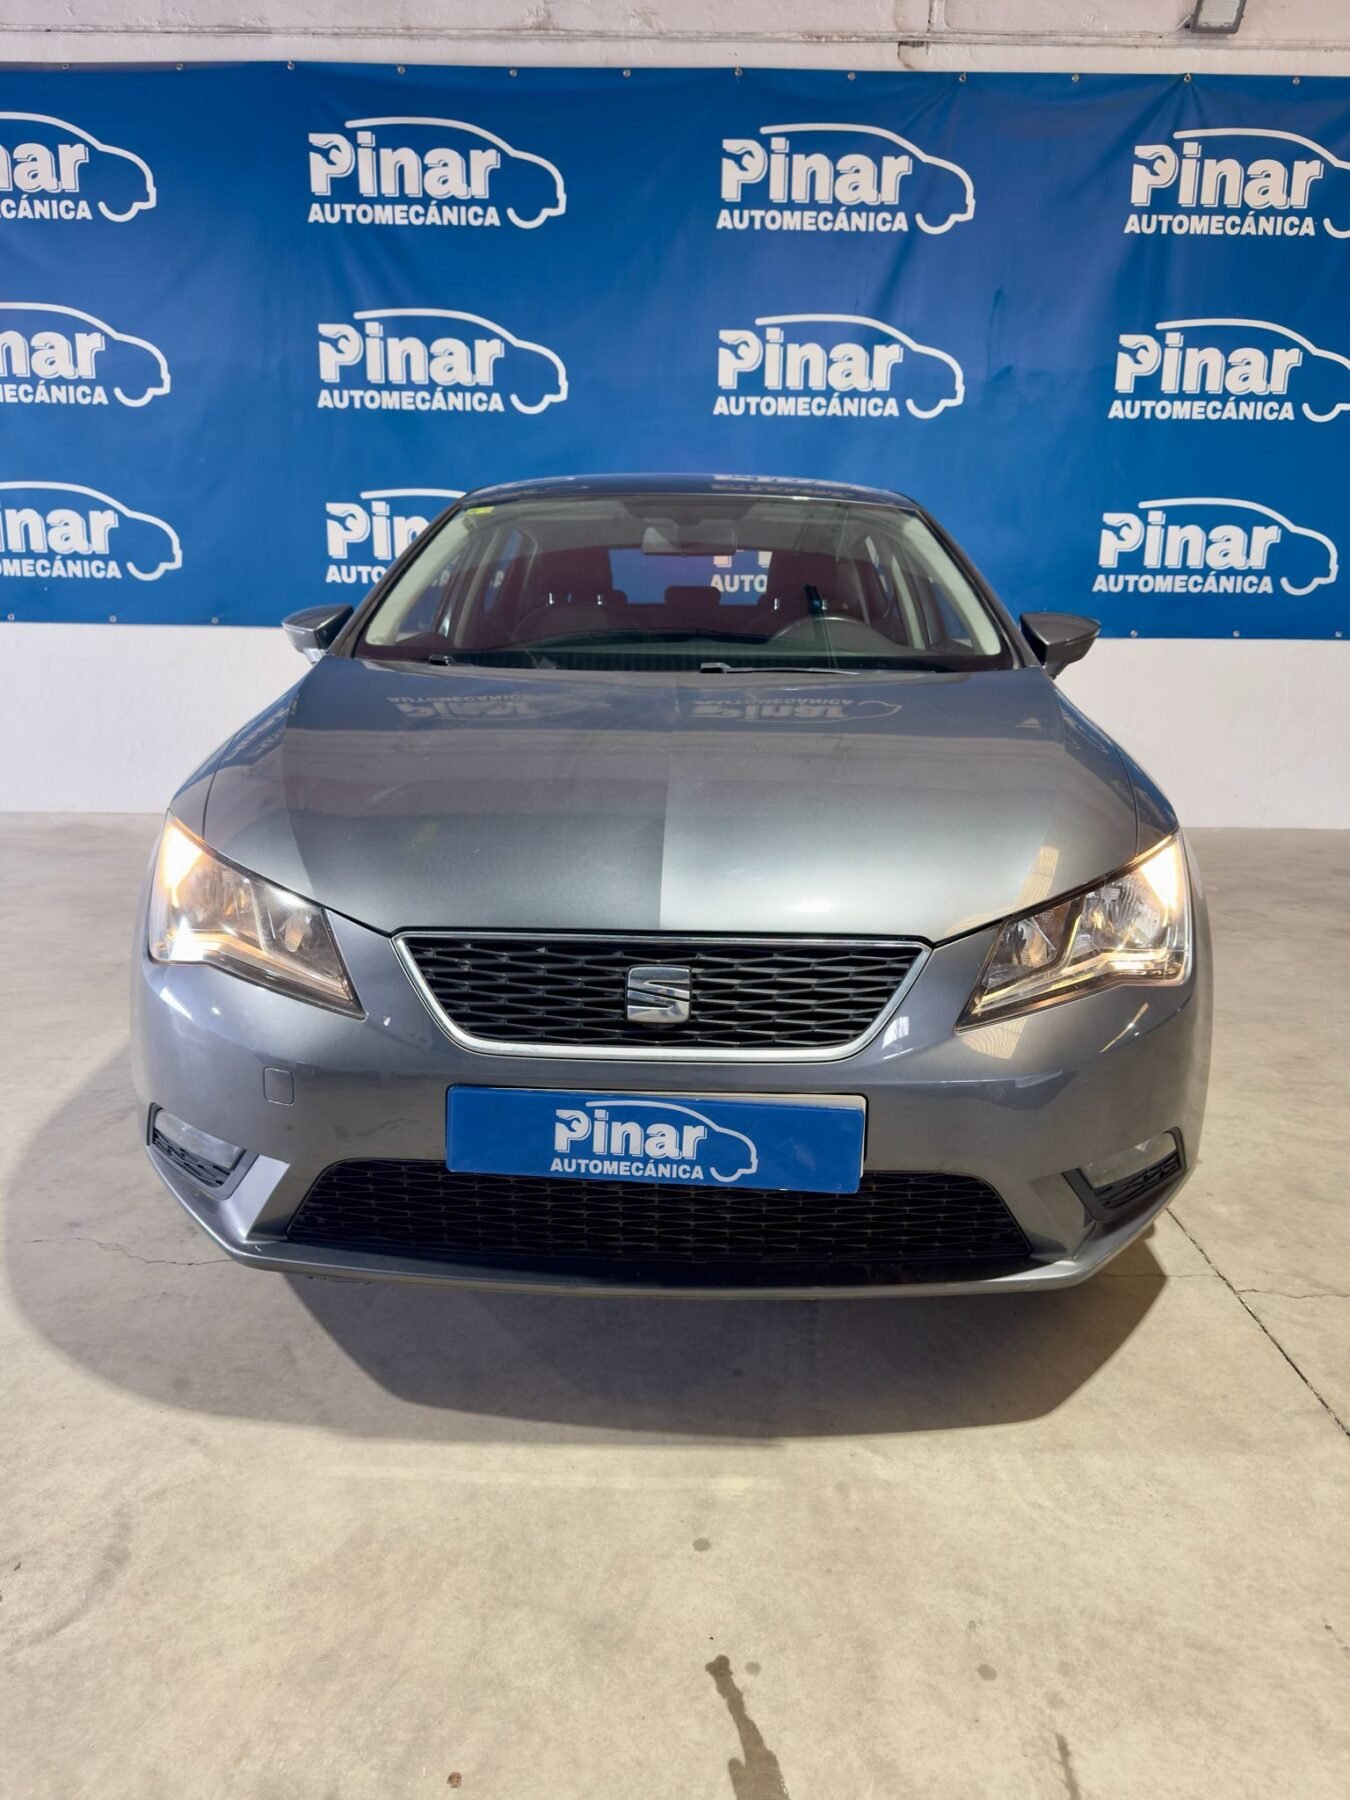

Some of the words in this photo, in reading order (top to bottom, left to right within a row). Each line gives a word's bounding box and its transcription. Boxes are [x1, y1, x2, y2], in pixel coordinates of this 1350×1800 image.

[308, 131, 501, 200] Pinar
[721, 137, 913, 206] Pinar
[1130, 141, 1324, 210] Pinar
[0, 194, 93, 220] CÁNICA
[308, 200, 501, 226] AUTOMECÁNICA
[716, 206, 909, 233] AUTOMECÁNICA
[1123, 211, 1316, 237] AUTOMECÁNICA
[317, 321, 505, 387] Pinar
[717, 326, 904, 393] Pinar
[1114, 332, 1303, 396] Pinar
[0, 380, 109, 405] ECÁNICA
[317, 386, 505, 412] AUTOMECÁNICA
[712, 391, 900, 418] AUTOMECÁNICA
[1107, 396, 1295, 421] AUTOMECÁNICA
[0, 508, 119, 555] nar
[1098, 510, 1282, 570] Pinar
[0, 555, 123, 579] MECÁNICA
[1092, 572, 1273, 594] AUTOMECÁNICA
[553, 1108, 707, 1160] Pinar
[550, 1158, 705, 1181] AUTOMECÁNICA
